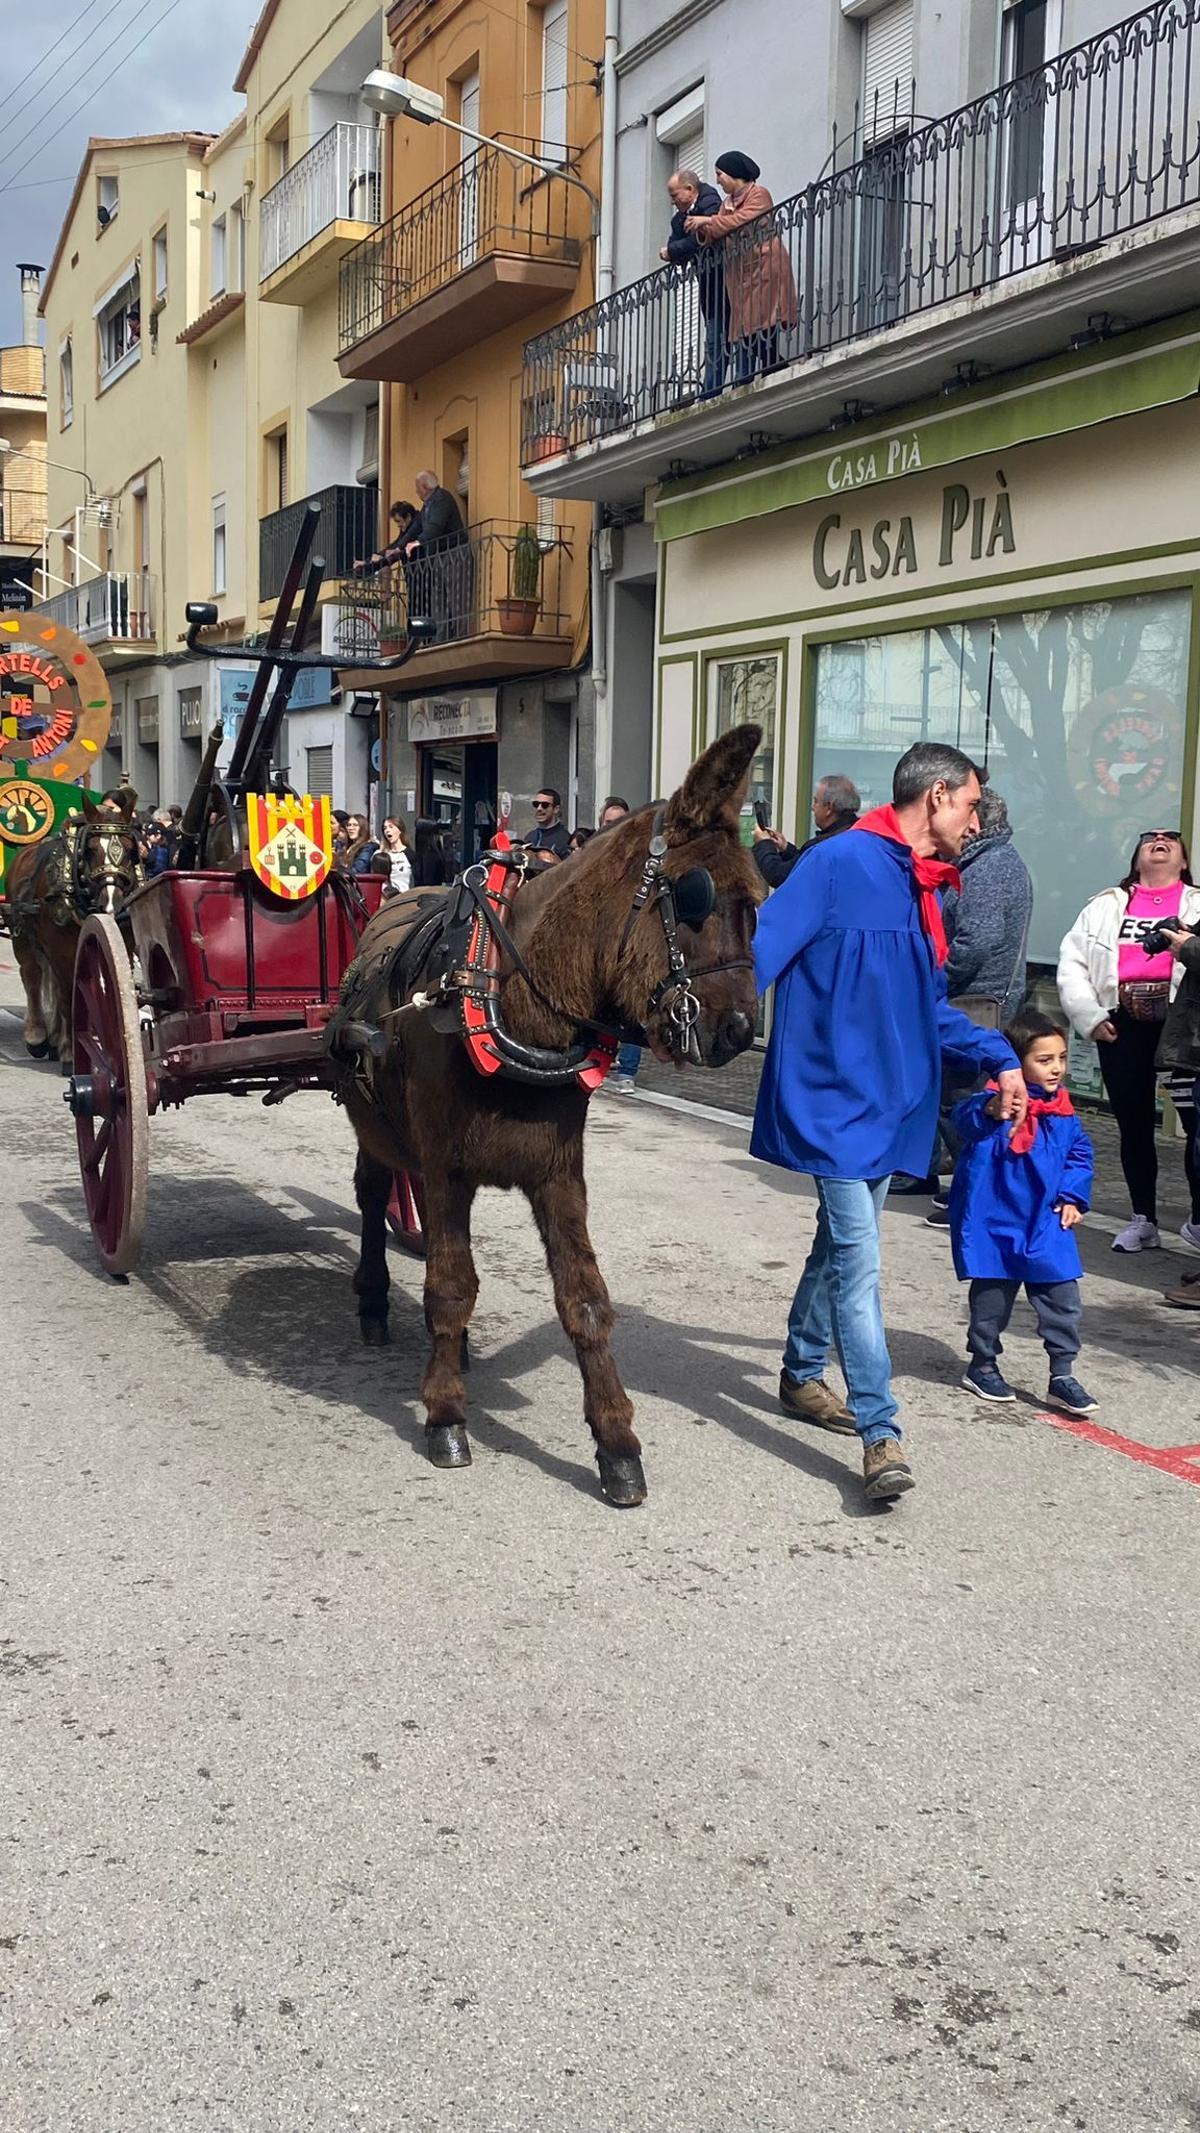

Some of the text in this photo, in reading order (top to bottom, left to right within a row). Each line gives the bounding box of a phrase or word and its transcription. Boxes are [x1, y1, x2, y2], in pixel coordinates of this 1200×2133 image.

[827, 432, 922, 490] CASA PIÀ
[813, 469, 1016, 590] CASA PIÀ
[11, 696, 32, 717] DE
[181, 699, 202, 727] PUJO
[32, 708, 74, 758] ANTONI
